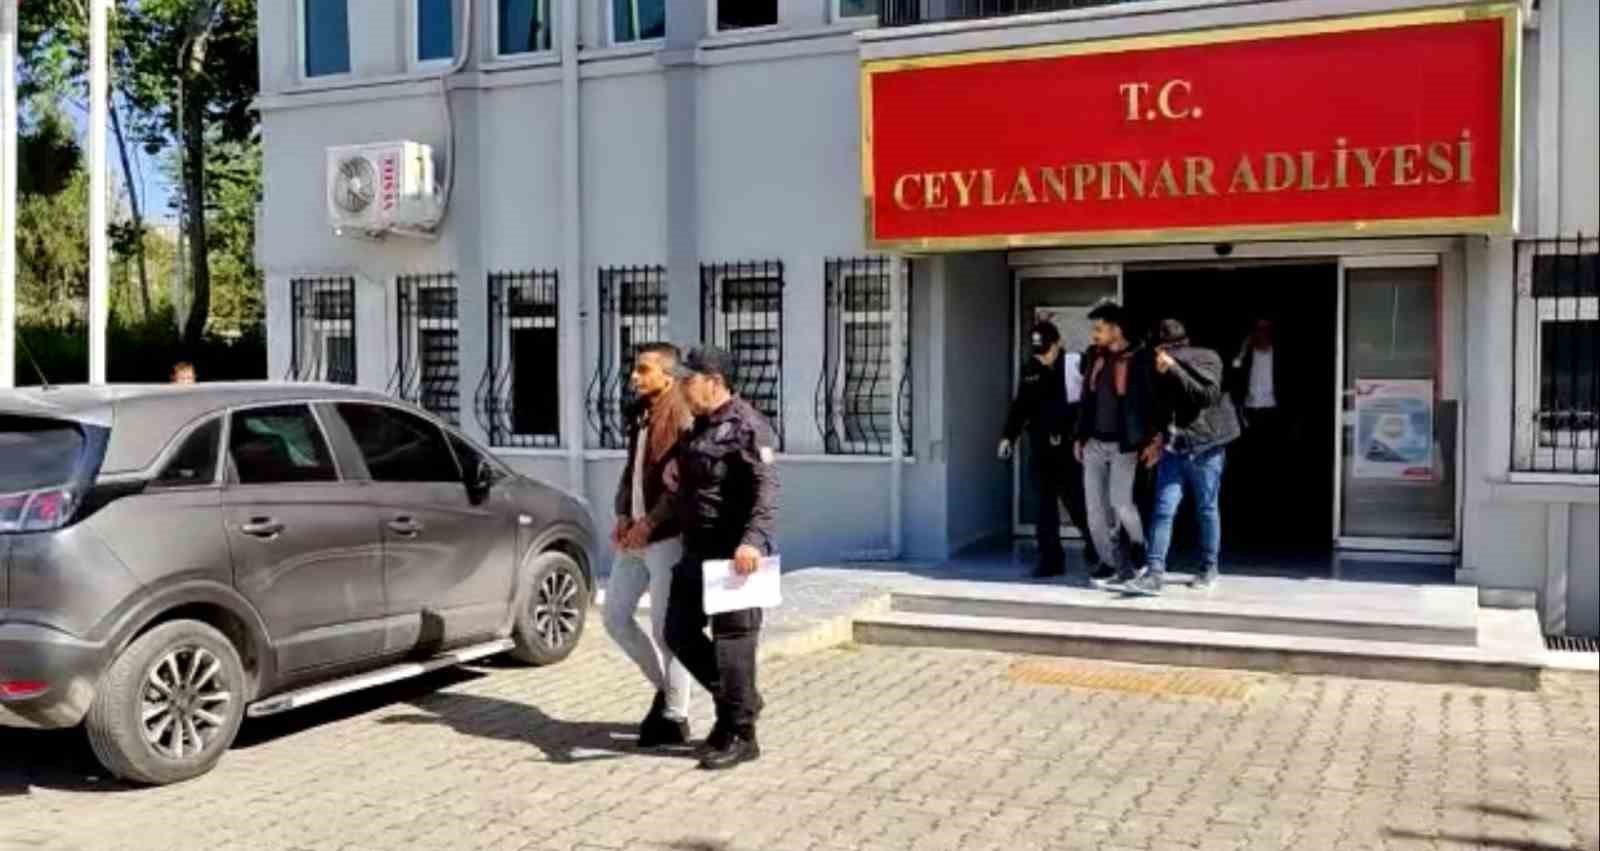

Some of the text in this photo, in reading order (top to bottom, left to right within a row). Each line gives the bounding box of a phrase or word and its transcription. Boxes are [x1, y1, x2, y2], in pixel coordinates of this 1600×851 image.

[1119, 79, 1203, 121] T.C.
[893, 128, 1474, 211] CEYLANPINAR ADLİYESİ
